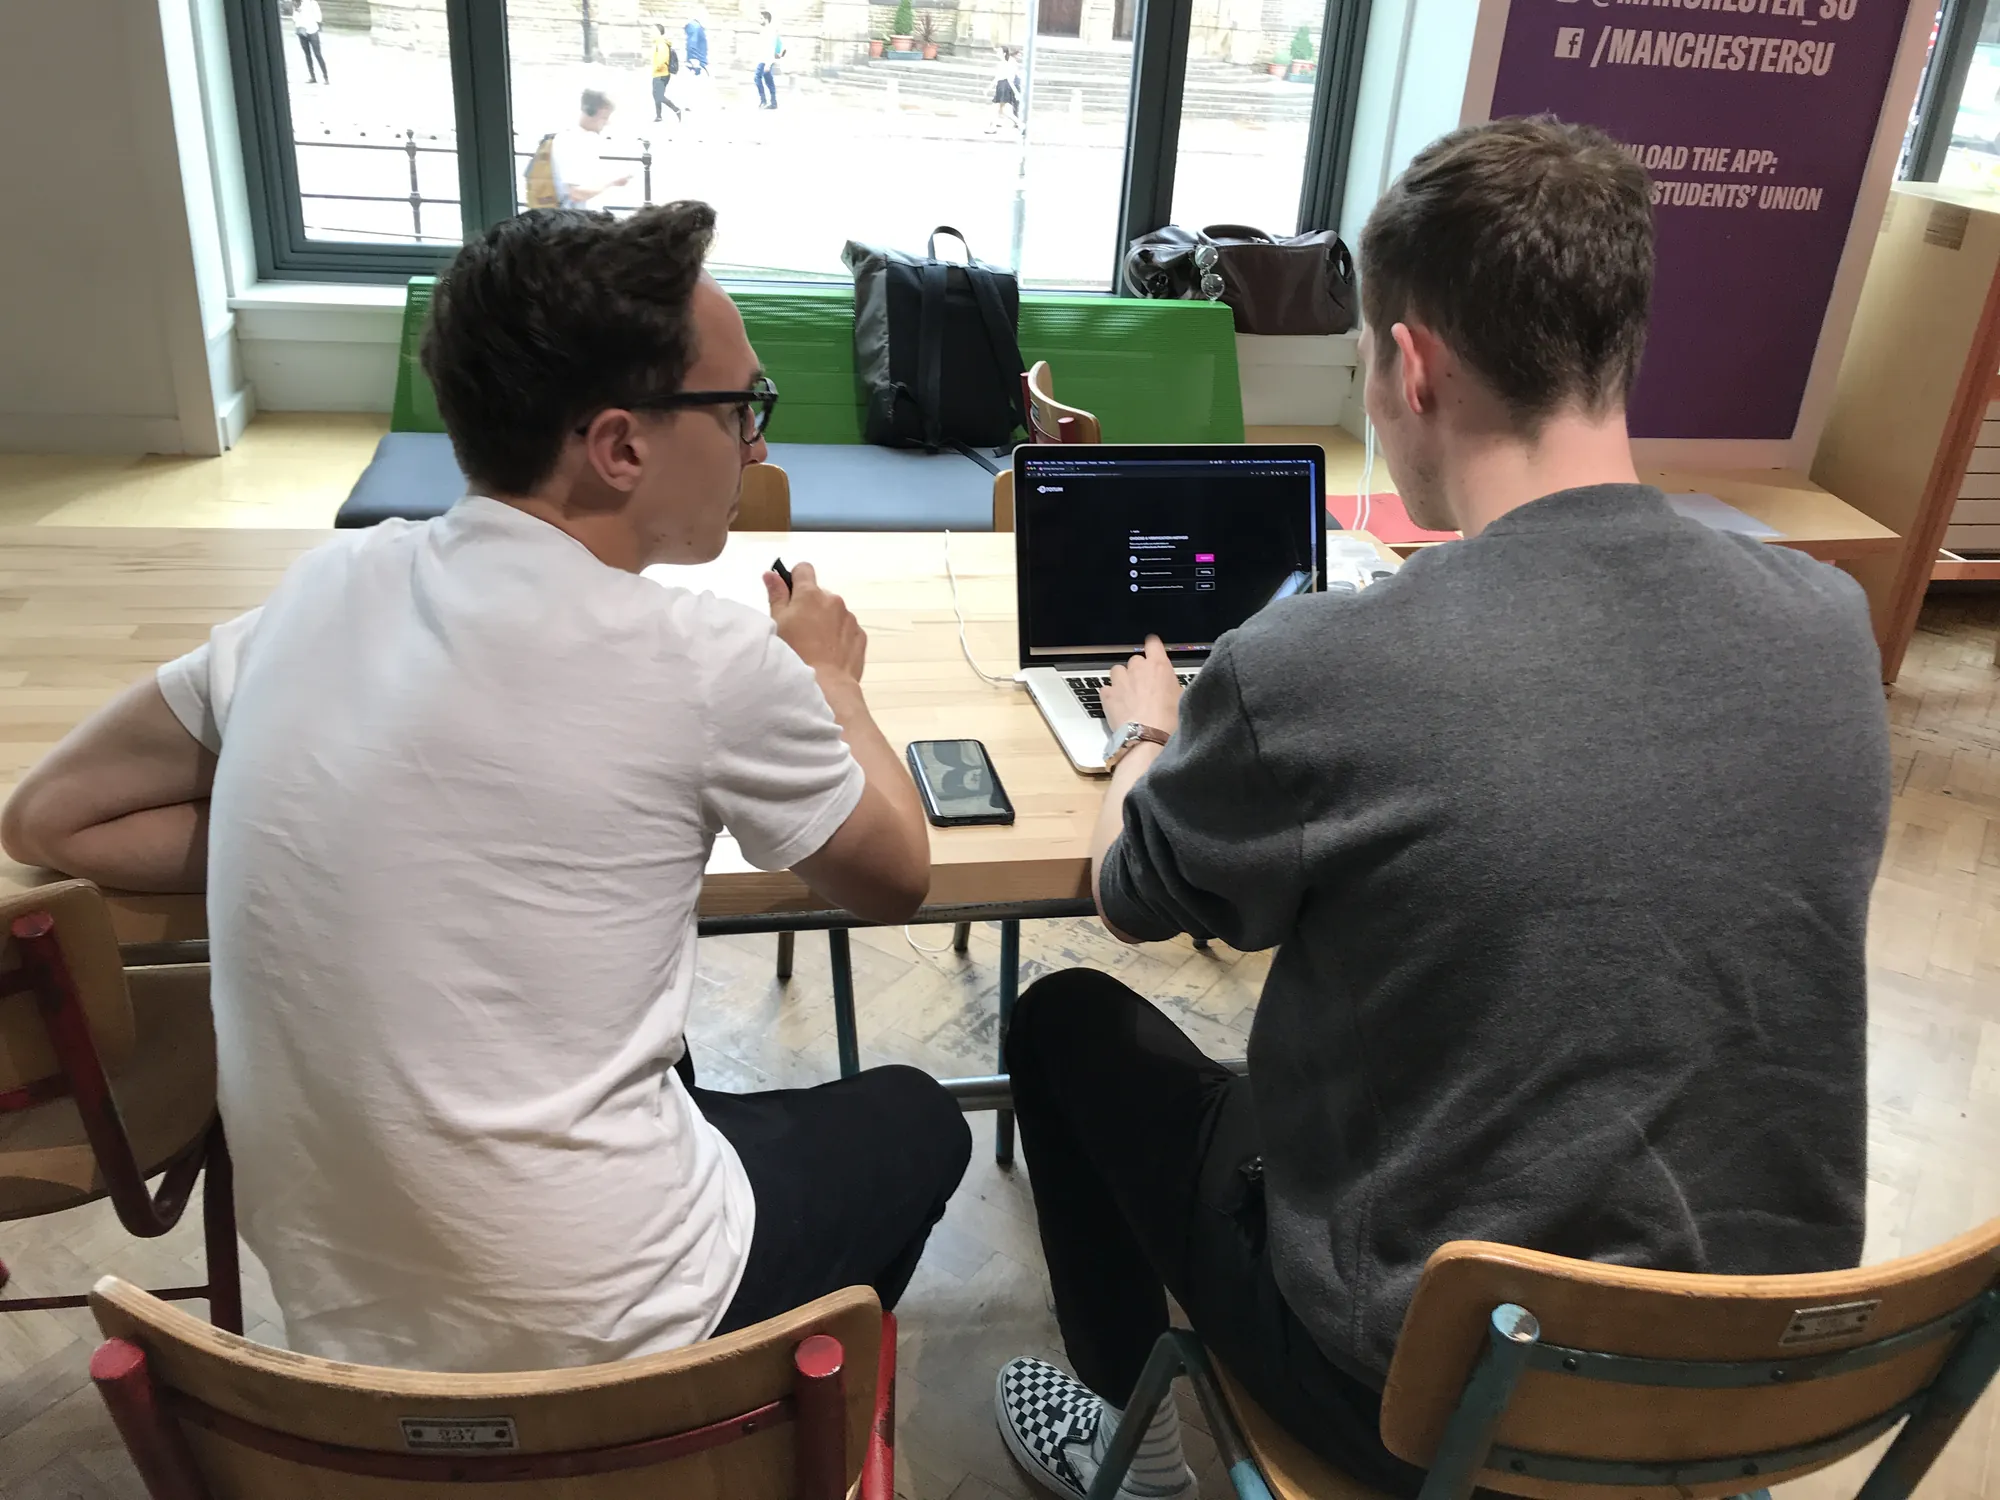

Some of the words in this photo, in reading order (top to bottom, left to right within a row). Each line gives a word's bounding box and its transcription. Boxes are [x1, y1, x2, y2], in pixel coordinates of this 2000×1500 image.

[1590, 25, 1836, 76] /MANCHESTERSU
[1692, 147, 1731, 172] THE
[1730, 149, 1778, 174] APP:
[1759, 185, 1824, 211] UNION
